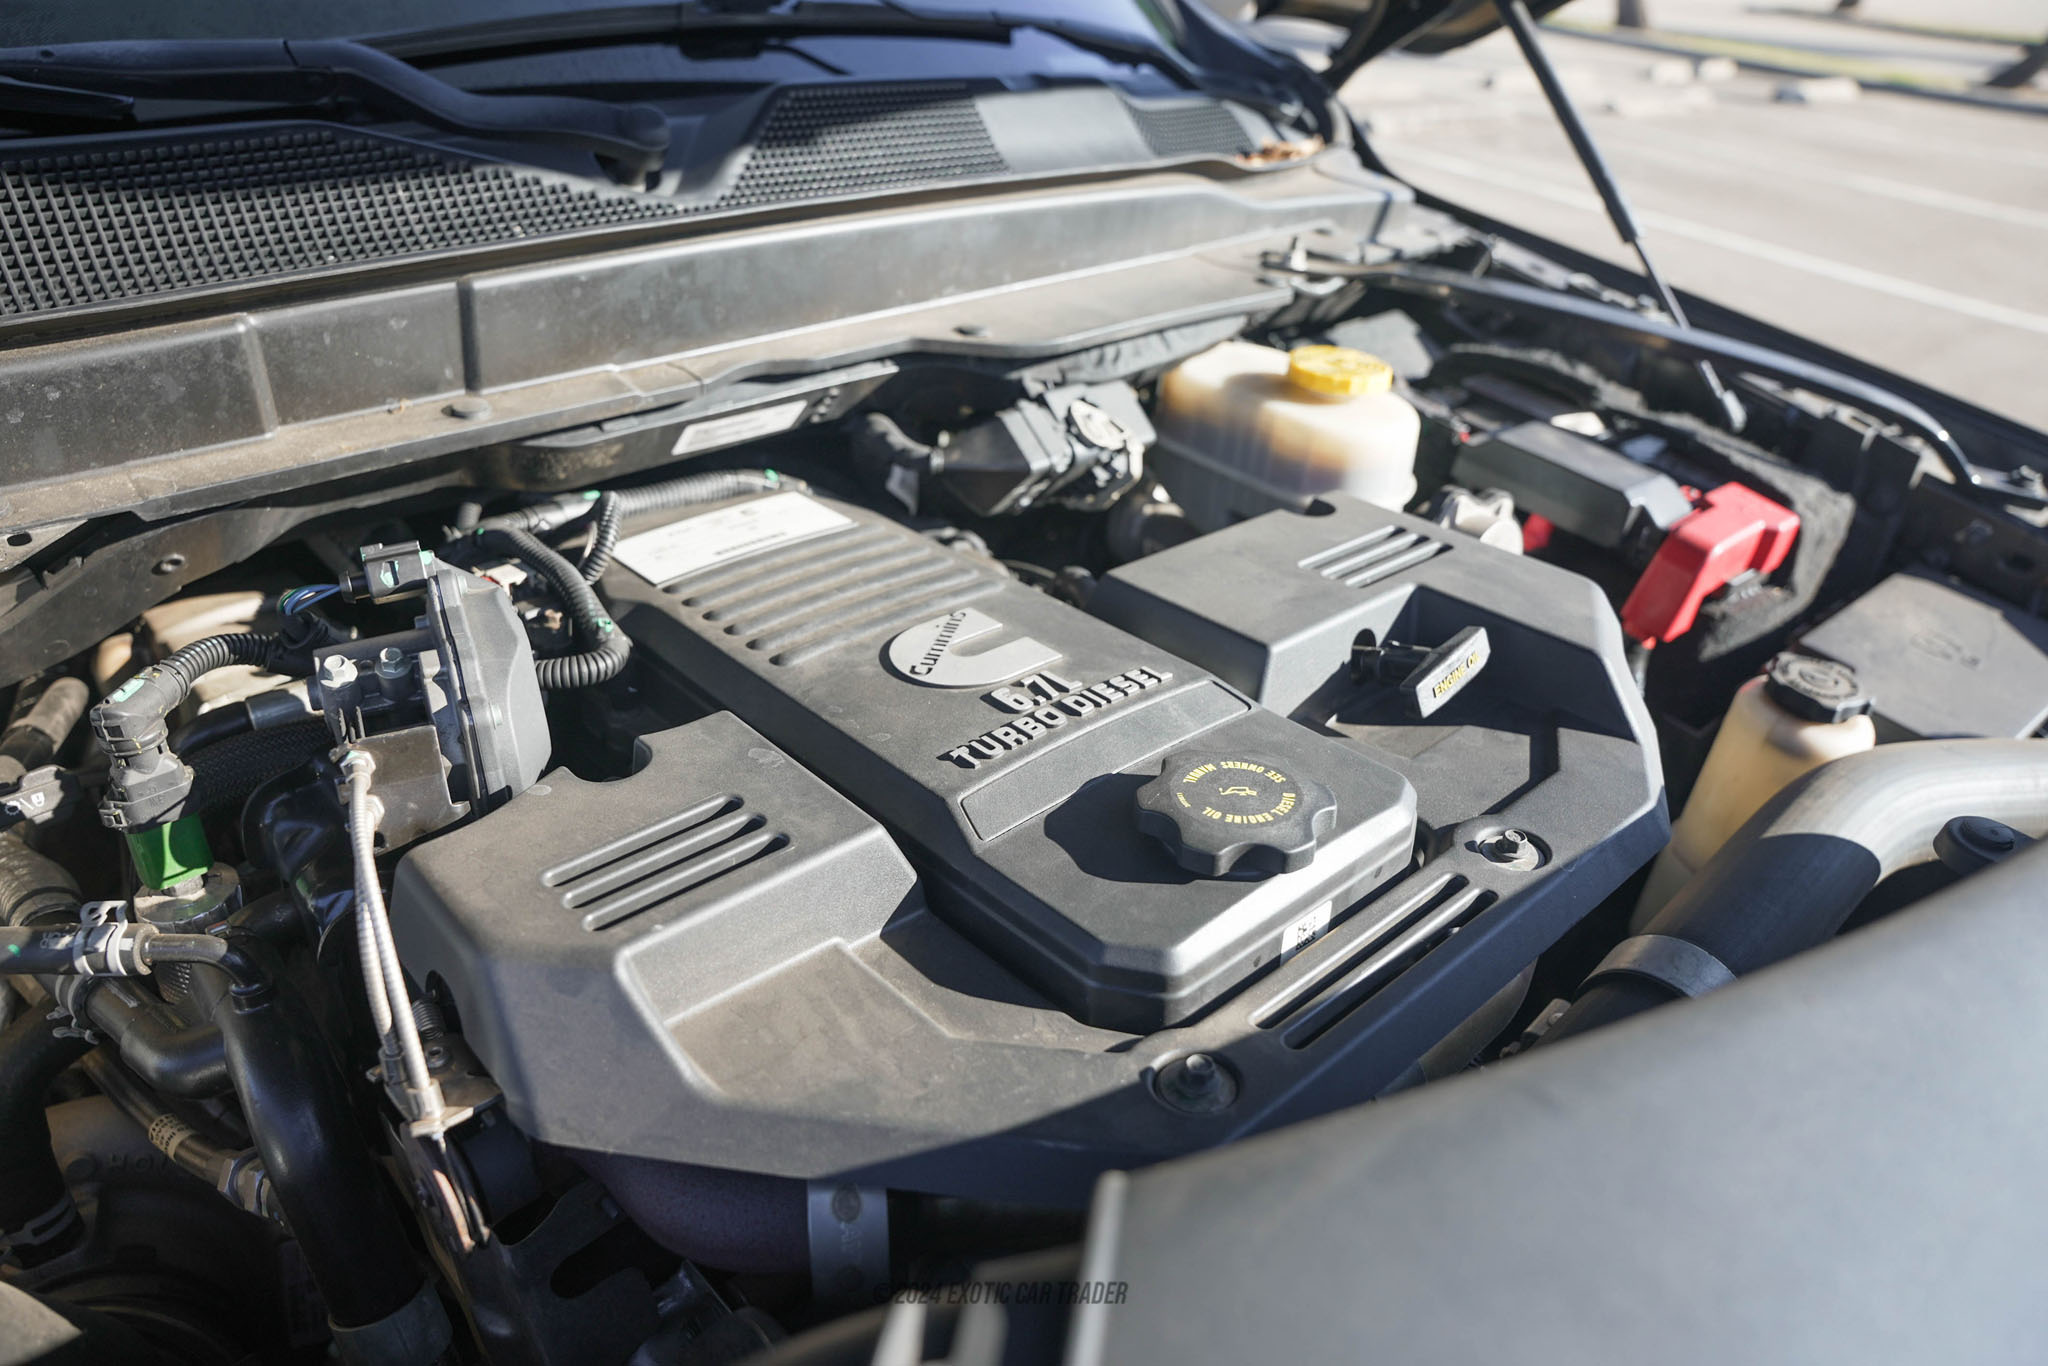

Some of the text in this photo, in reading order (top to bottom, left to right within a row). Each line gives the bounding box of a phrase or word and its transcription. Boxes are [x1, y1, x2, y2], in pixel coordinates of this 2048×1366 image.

[909, 609, 967, 676] Cummins
[985, 669, 1083, 715] 6.7L
[1432, 662, 1466, 698] ENGINE
[946, 665, 1174, 770] TURBO DIESEL
[1182, 761, 1286, 783] SEE OWNERS MANUAL
[1202, 792, 1296, 823] DIESEL ENGINE OIL
